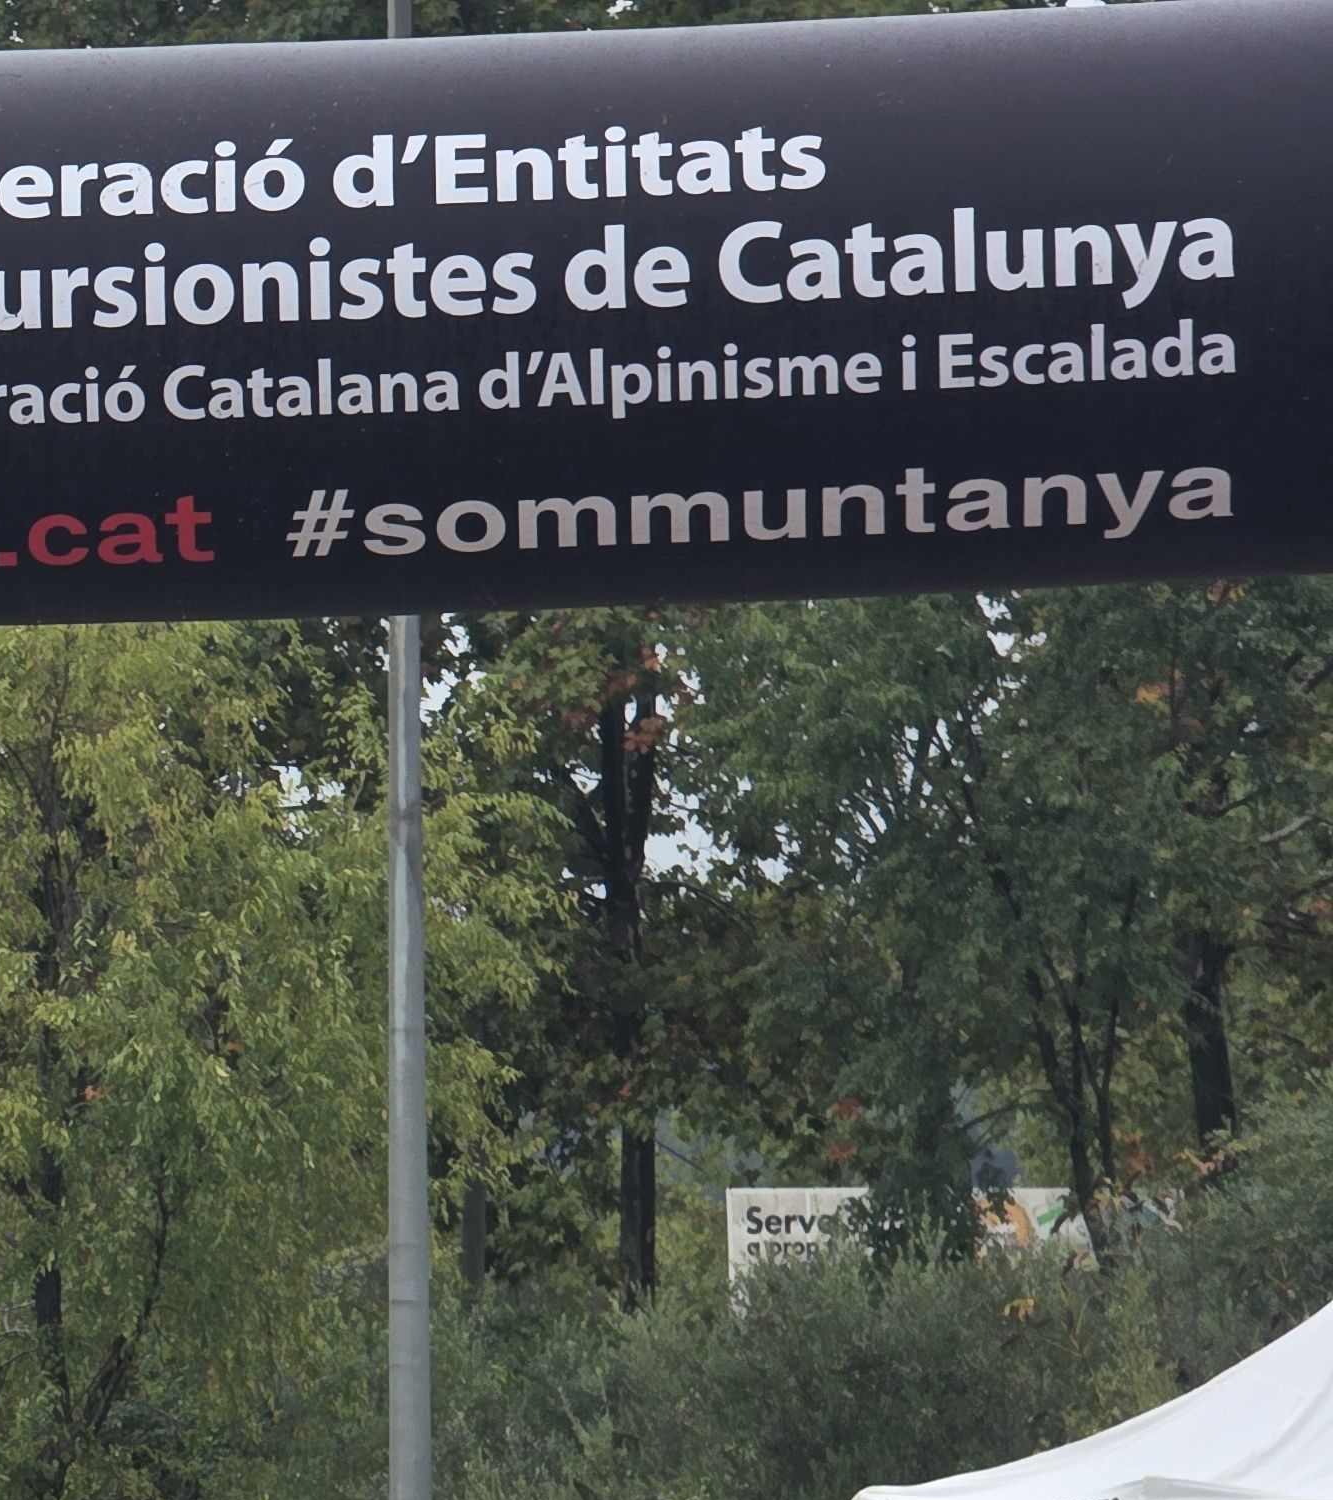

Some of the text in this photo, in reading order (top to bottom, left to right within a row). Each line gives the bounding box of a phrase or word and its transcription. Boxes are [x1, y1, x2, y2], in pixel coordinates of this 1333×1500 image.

[565, 225, 691, 312] de
[719, 207, 1235, 309] Catalunya
[164, 358, 460, 420] Catalana
[902, 351, 916, 391] i
[939, 318, 1236, 390] Escalada
[287, 468, 1230, 557] #sommuntanya
